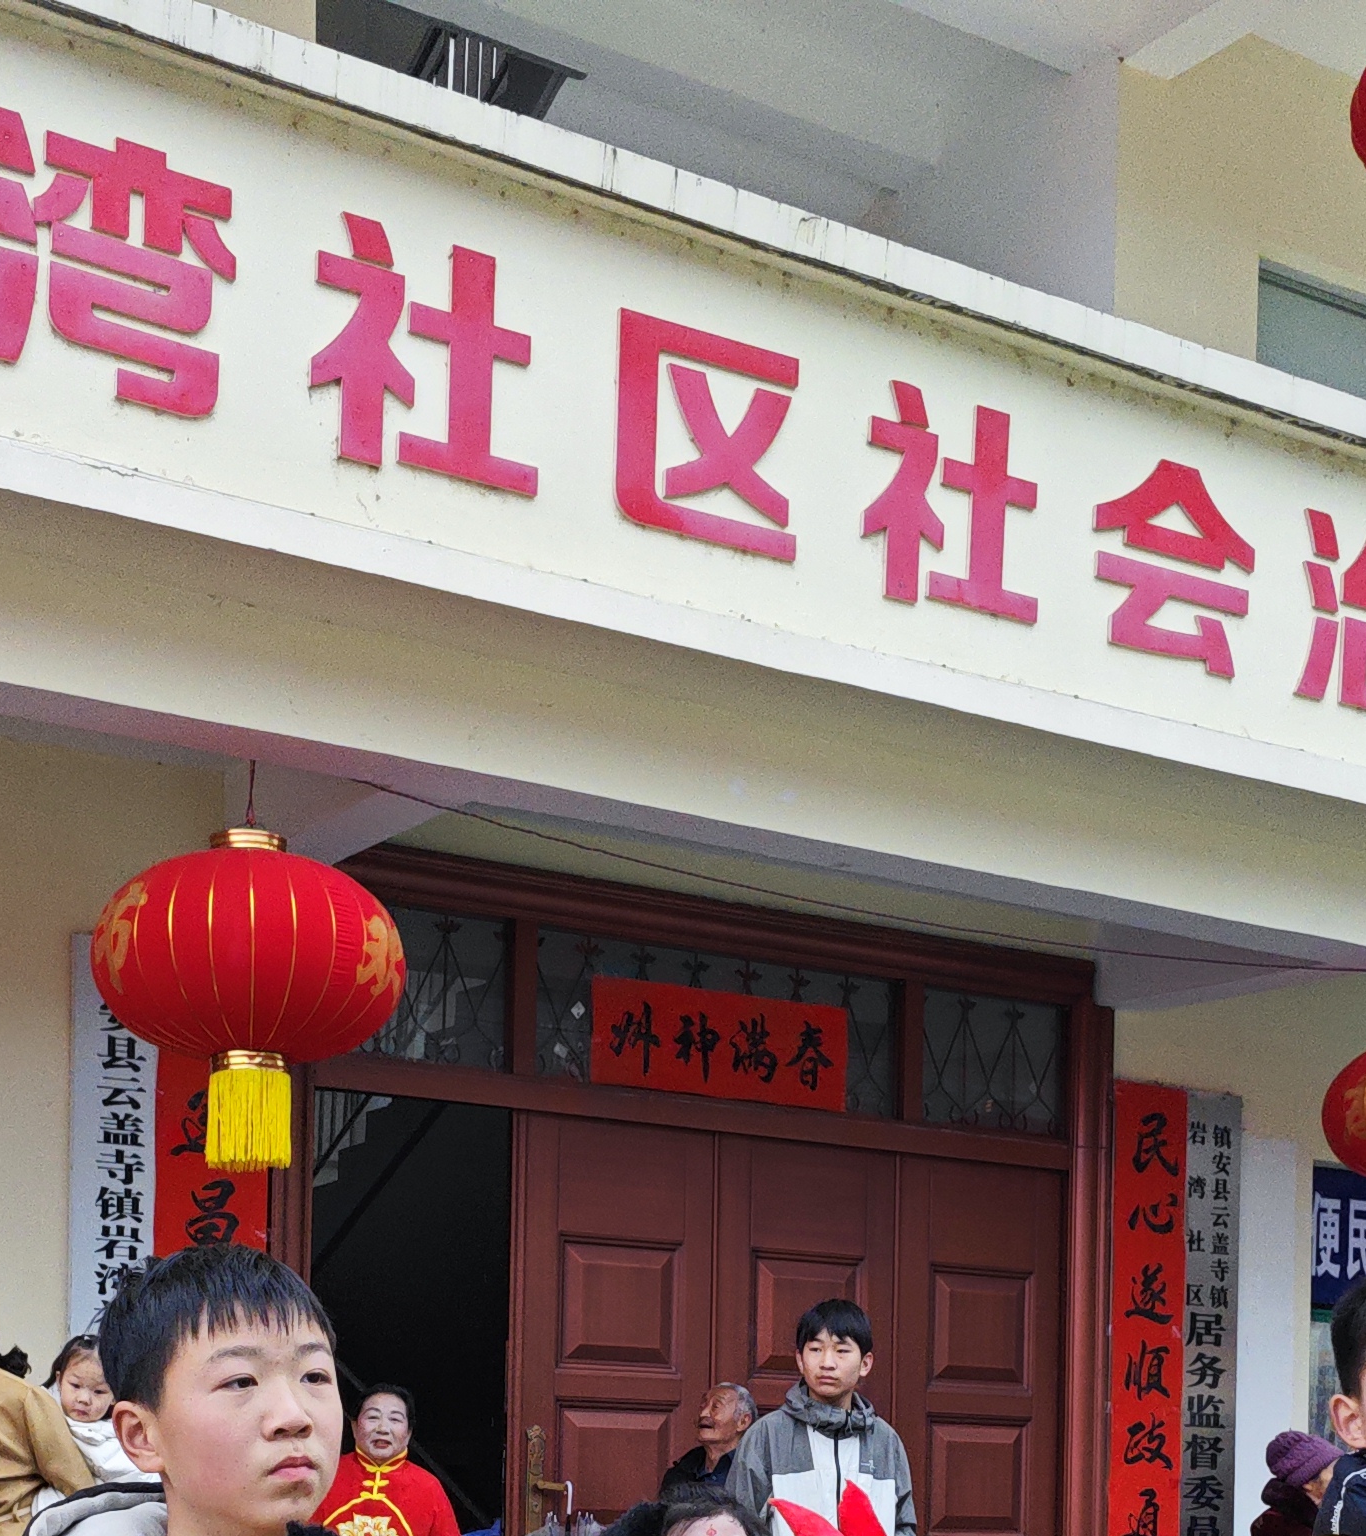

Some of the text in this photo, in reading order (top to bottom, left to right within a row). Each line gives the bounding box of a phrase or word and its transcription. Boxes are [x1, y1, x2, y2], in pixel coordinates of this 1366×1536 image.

[1186, 1121, 1207, 1306] 岩湾社区
[1210, 1124, 1232, 1309] 镇安县云盖寺镇
